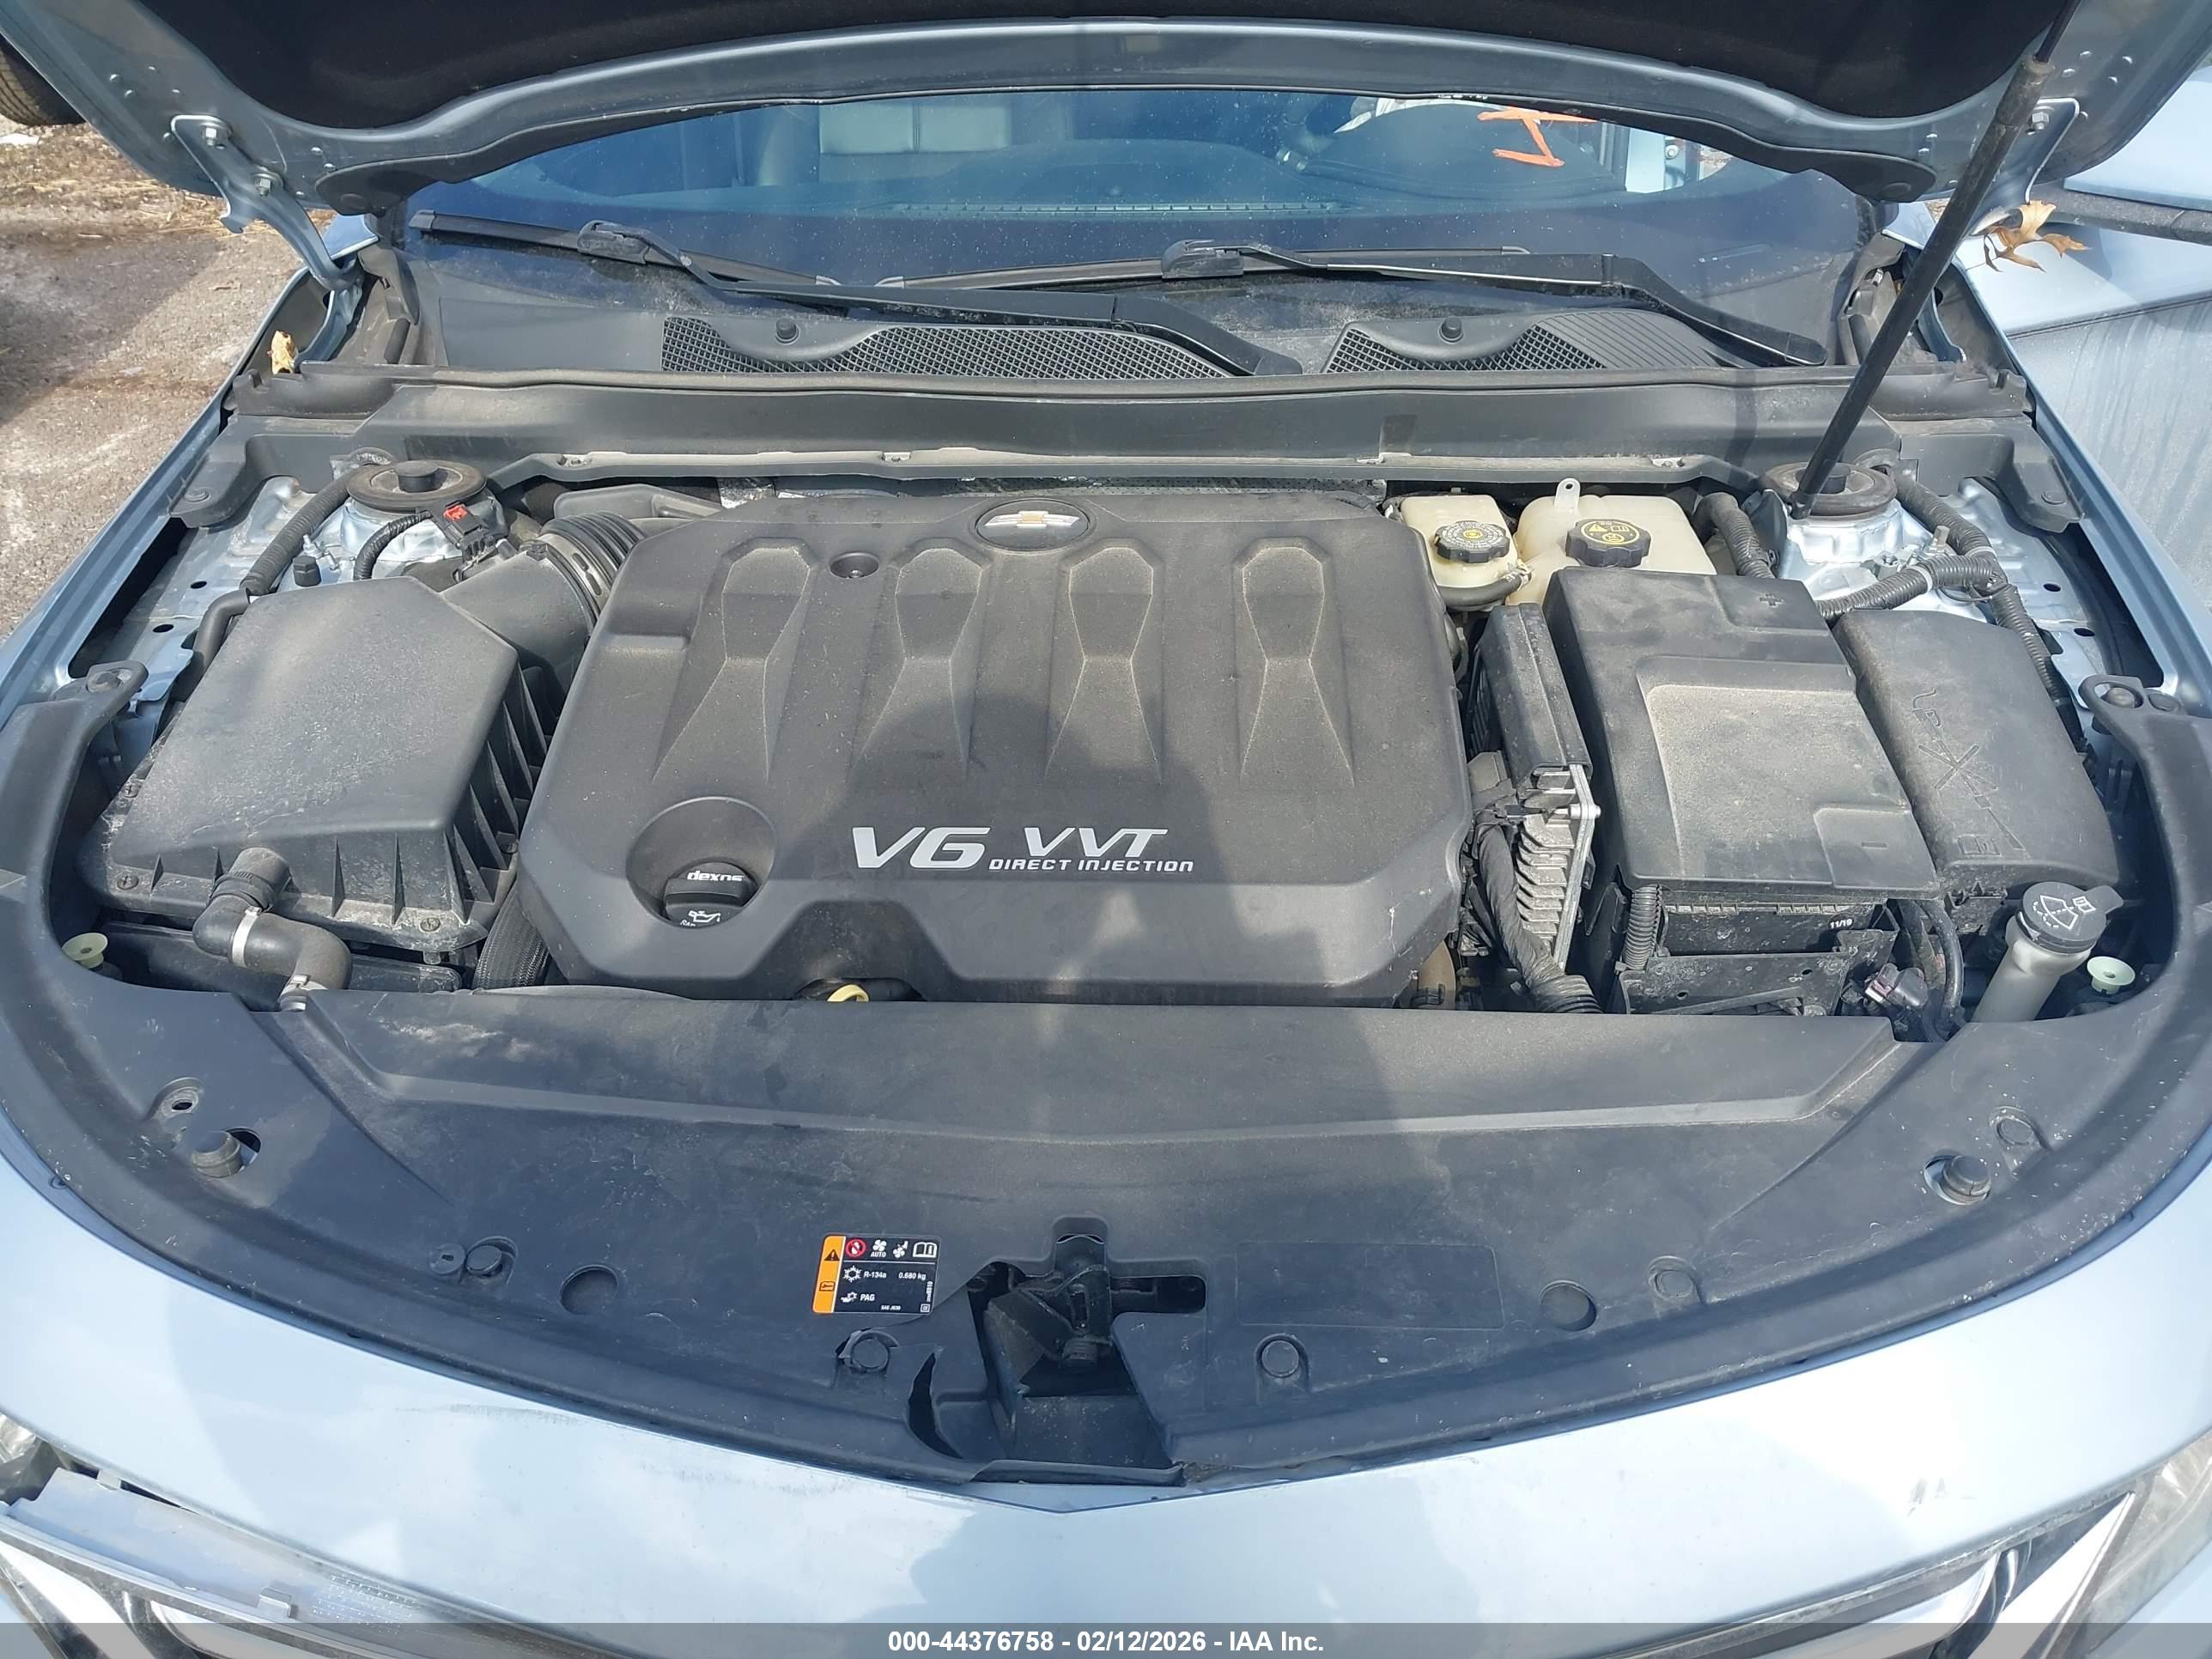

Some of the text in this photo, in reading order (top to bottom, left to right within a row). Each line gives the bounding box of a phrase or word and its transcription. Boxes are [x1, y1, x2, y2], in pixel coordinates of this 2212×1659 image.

[852, 826, 1169, 870] V6 VVT
[988, 859, 1194, 872] DIRECT INJECTION
[1829, 918, 1853, 929] 11/19
[917, 1272, 927, 1281] kg
[860, 1293, 875, 1302] PAG
